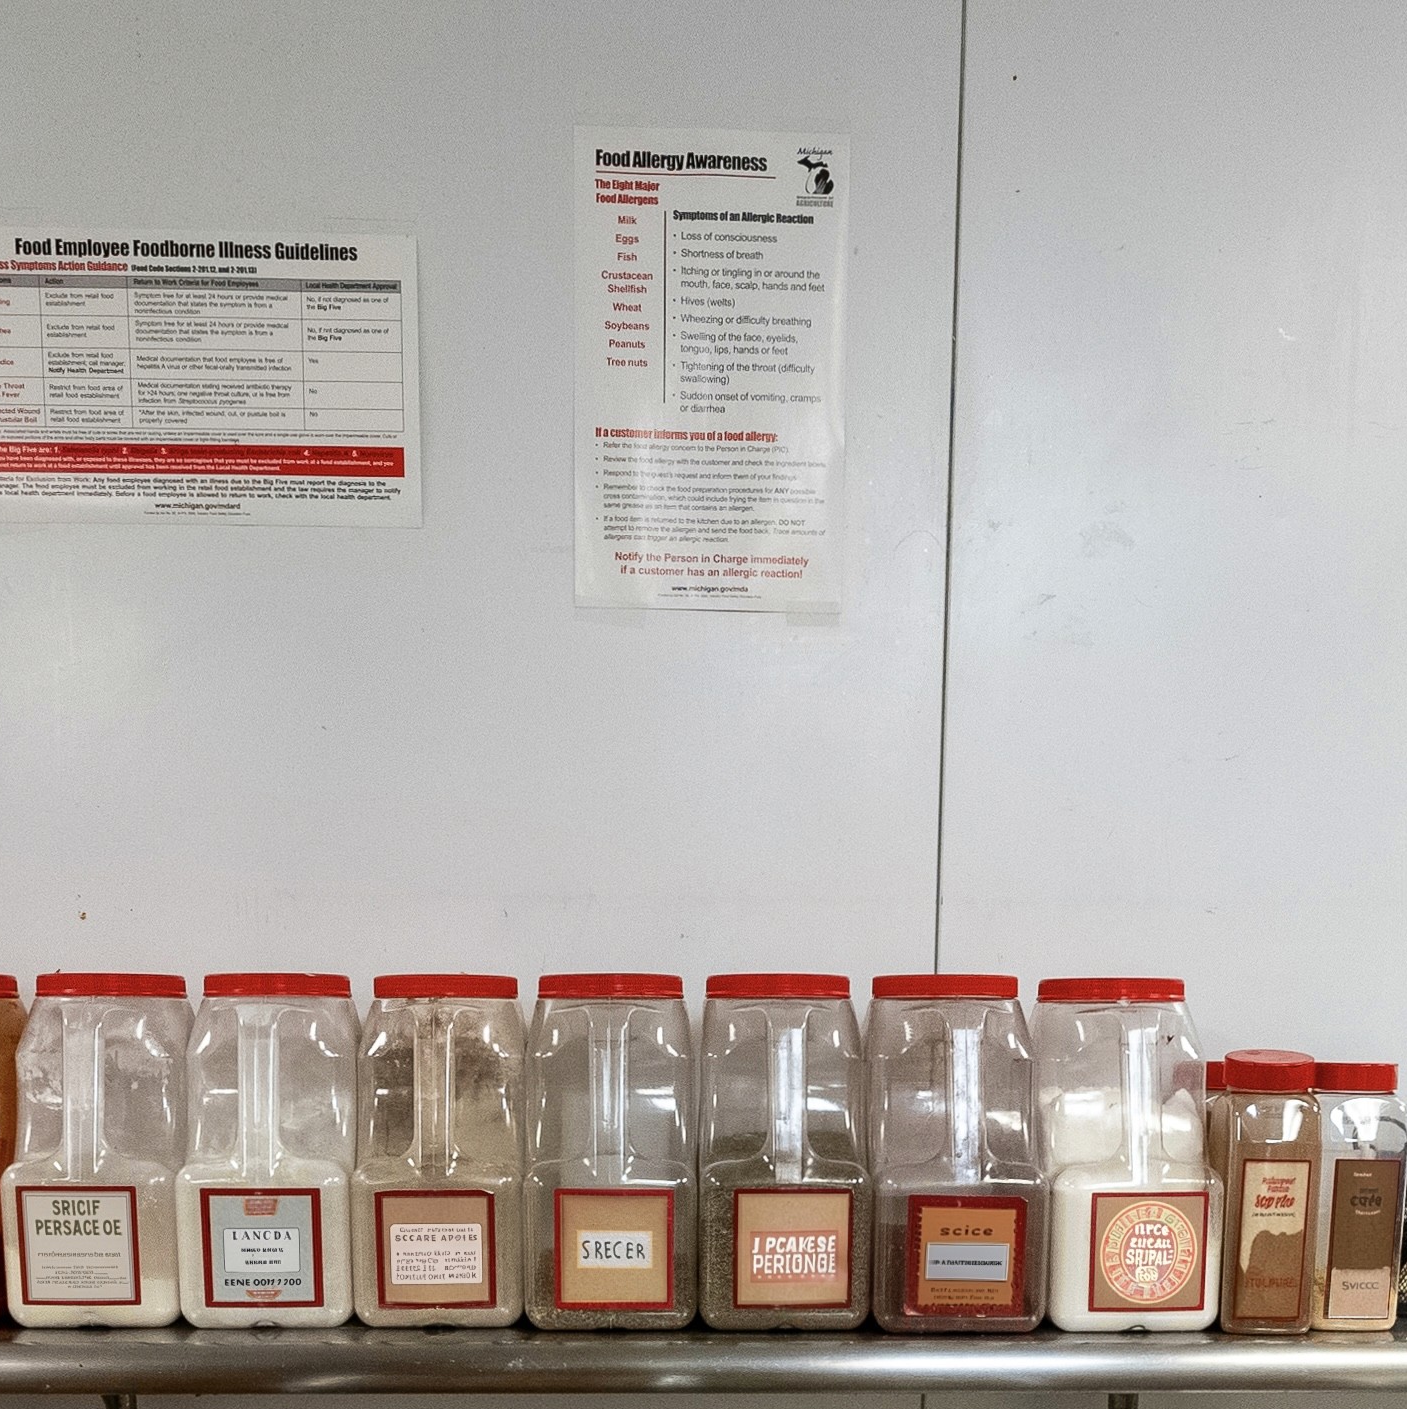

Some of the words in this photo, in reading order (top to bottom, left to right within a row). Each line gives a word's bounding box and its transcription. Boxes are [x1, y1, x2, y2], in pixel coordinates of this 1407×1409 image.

[595, 149, 630, 167] Food
[632, 150, 684, 171] Allergy
[686, 152, 768, 172] Awareness
[595, 179, 611, 189] The
[612, 180, 633, 191] Eight
[635, 181, 660, 192] Major
[596, 193, 616, 203] Food
[617, 194, 659, 205] Allergens
[617, 215, 637, 225] Milk
[673, 210, 718, 221] Symptoms
[719, 211, 729, 221] of
[729, 212, 740, 221] an
[741, 212, 775, 223] Allergic
[776, 213, 815, 224] Reaction
[615, 233, 640, 245] Eggs
[681, 231, 702, 241] Loss
[704, 232, 713, 241] of
[715, 233, 778, 243] consciousness
[15, 237, 52, 256] Food
[55, 239, 130, 258] Employee
[133, 240, 215, 258] Foodborne
[218, 241, 272, 259] Illness
[275, 242, 359, 261] Guidelines
[681, 249, 724, 259] Shortness
[726, 250, 735, 259] of
[736, 250, 764, 260] breath
[617, 252, 637, 261] Fish
[10, 260, 56, 271] Symptoms
[58, 261, 86, 271] Action
[87, 261, 129, 272] Guidance
[601, 270, 653, 281] Crustacean
[681, 266, 709, 278] Itching
[711, 269, 720, 277] or
[722, 268, 752, 279] tingling
[754, 269, 762, 277] in
[775, 270, 804, 279] around
[806, 270, 820, 279] the
[607, 284, 647, 294] Shellfish
[762, 281, 789, 291] hands
[790, 282, 806, 291] and
[808, 282, 825, 292] feet
[612, 302, 642, 312] Wheat
[681, 296, 705, 306] Hives
[604, 321, 650, 332] Soybeans
[681, 314, 723, 326] Wheezing
[725, 316, 734, 324] or
[772, 316, 812, 328] breathing
[718, 332, 726, 342] of
[728, 333, 742, 342] the
[608, 339, 646, 349] Peanuts
[606, 357, 626, 367] Tree
[627, 358, 648, 368] nuts
[595, 427, 602, 438] If
[609, 428, 653, 439] customer
[654, 429, 688, 440] informs
[689, 431, 705, 442] you
[706, 430, 716, 441] of
[724, 431, 744, 441] food
[745, 431, 778, 443] allergy:
[9, 446, 21, 454] Big
[614, 552, 644, 564] Notify
[646, 553, 662, 562] the
[664, 553, 698, 563] Person
[701, 554, 711, 563] in
[713, 554, 748, 566] Charge
[750, 554, 810, 567] immediately
[620, 564, 628, 574] if
[629, 567, 636, 575] a
[638, 567, 685, 576] customer
[687, 567, 705, 577] has
[707, 569, 720, 577] an
[722, 567, 758, 580] allergic
[760, 569, 803, 579] reaction!
[35, 1219, 100, 1236] PERSACE
[103, 1220, 122, 1236] OE
